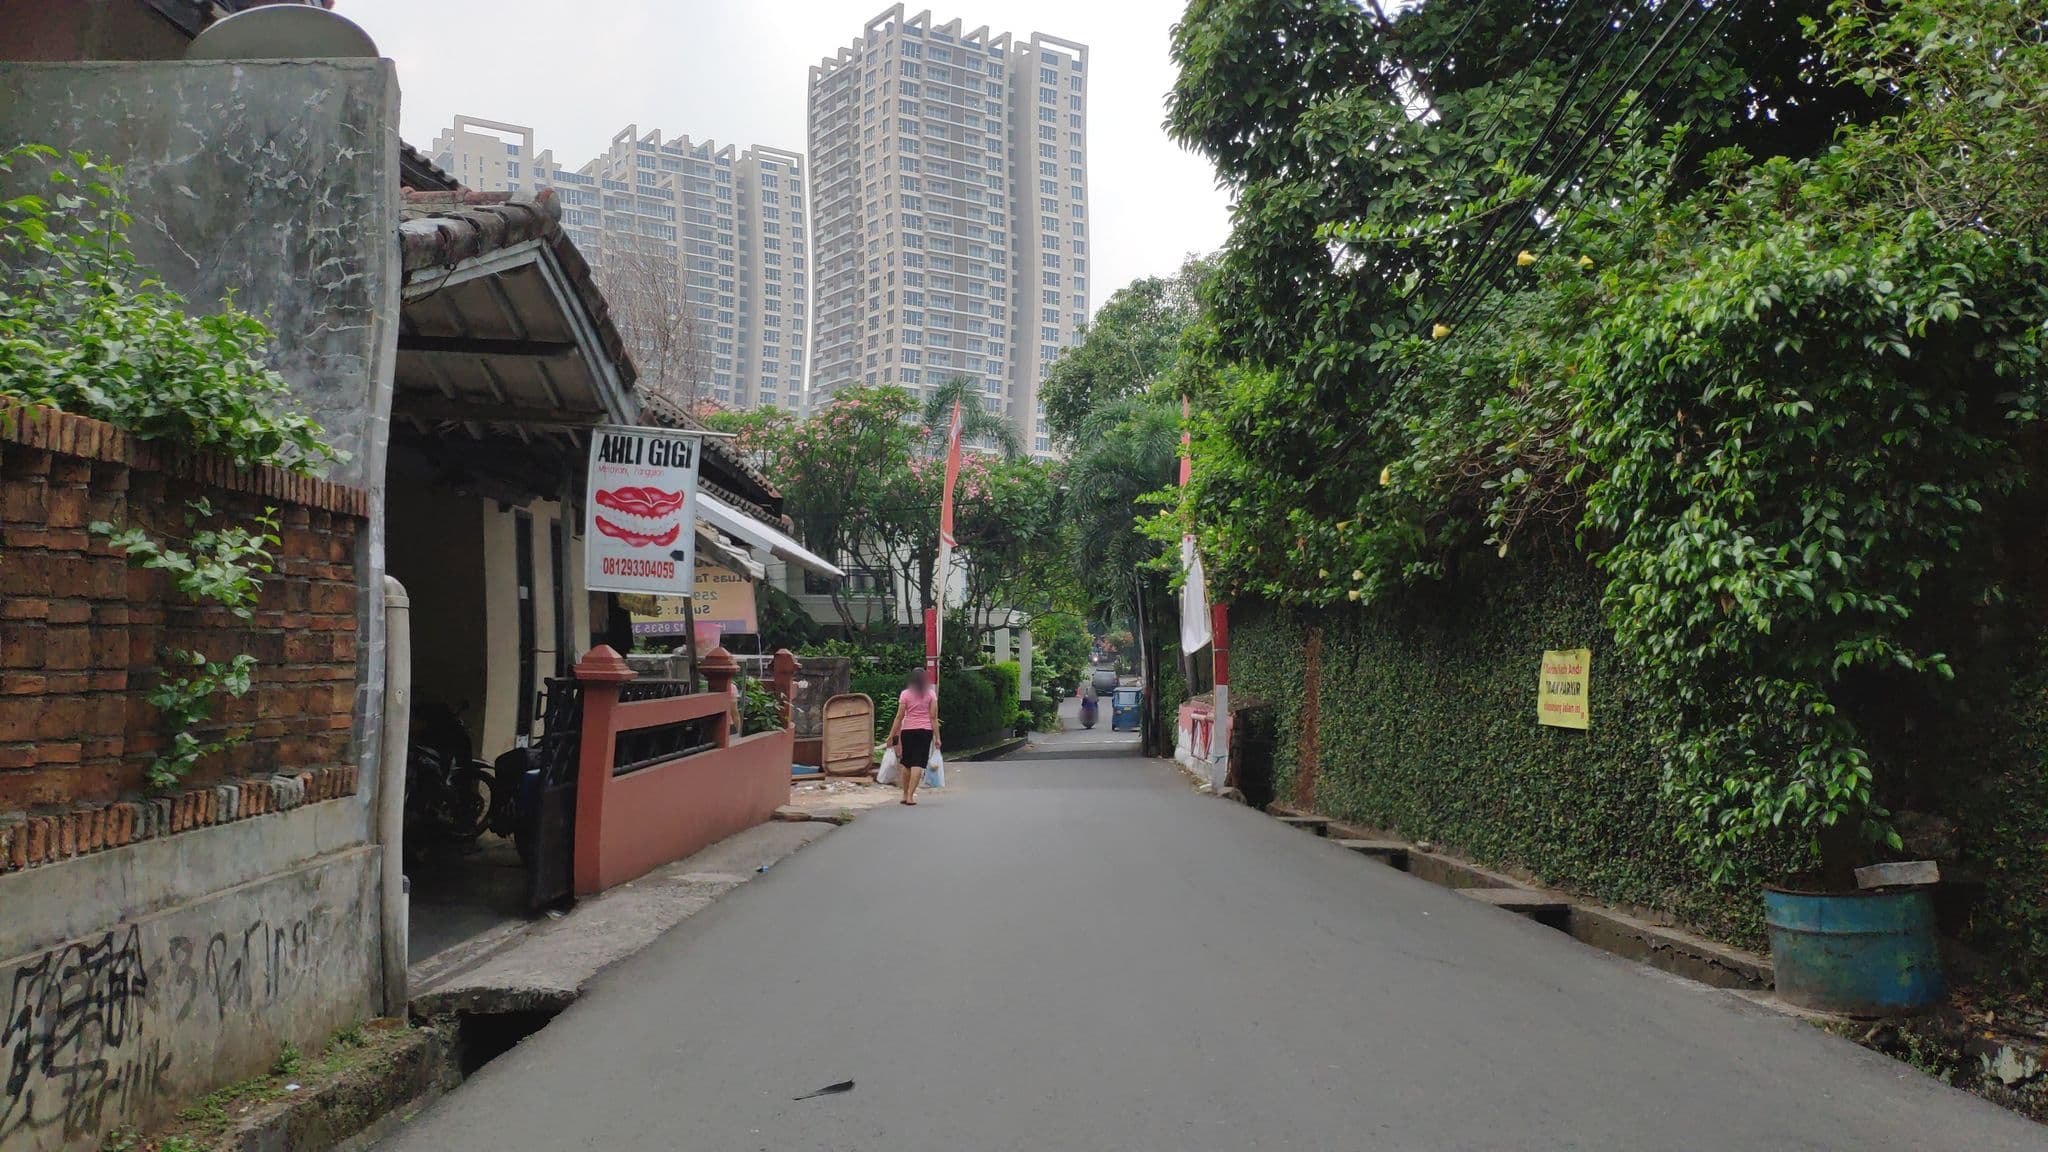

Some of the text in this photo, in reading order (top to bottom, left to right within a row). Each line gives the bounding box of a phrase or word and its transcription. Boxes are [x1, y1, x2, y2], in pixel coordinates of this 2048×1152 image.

[598, 435, 693, 469] AHLI GIGI
[602, 557, 675, 579] 081293304059
